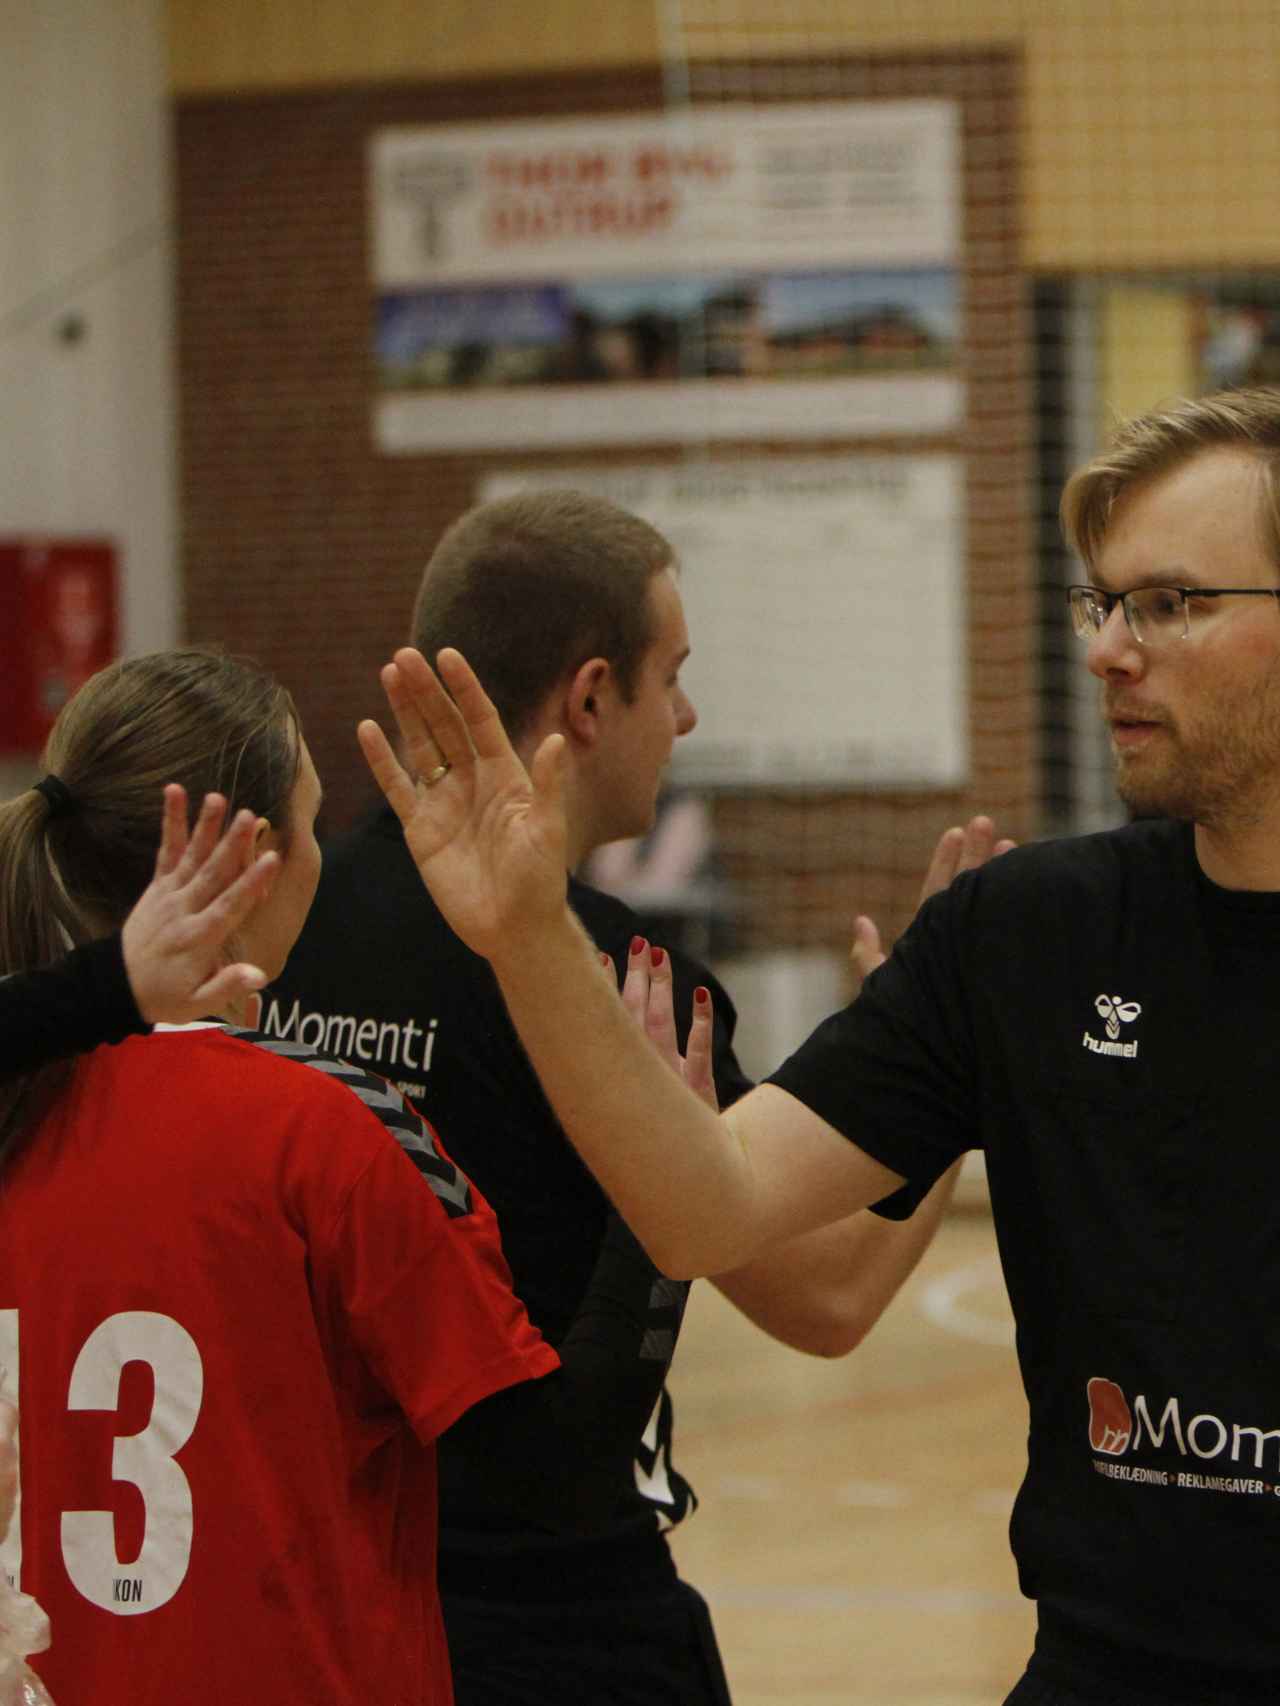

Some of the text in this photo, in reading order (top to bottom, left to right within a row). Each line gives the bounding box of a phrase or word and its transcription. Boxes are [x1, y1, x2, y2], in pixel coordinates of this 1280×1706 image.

[263, 999, 439, 1072] Momenti
[1083, 1031, 1139, 1058] hummel
[1177, 1472, 1264, 1494] REKLAMEGAVER
